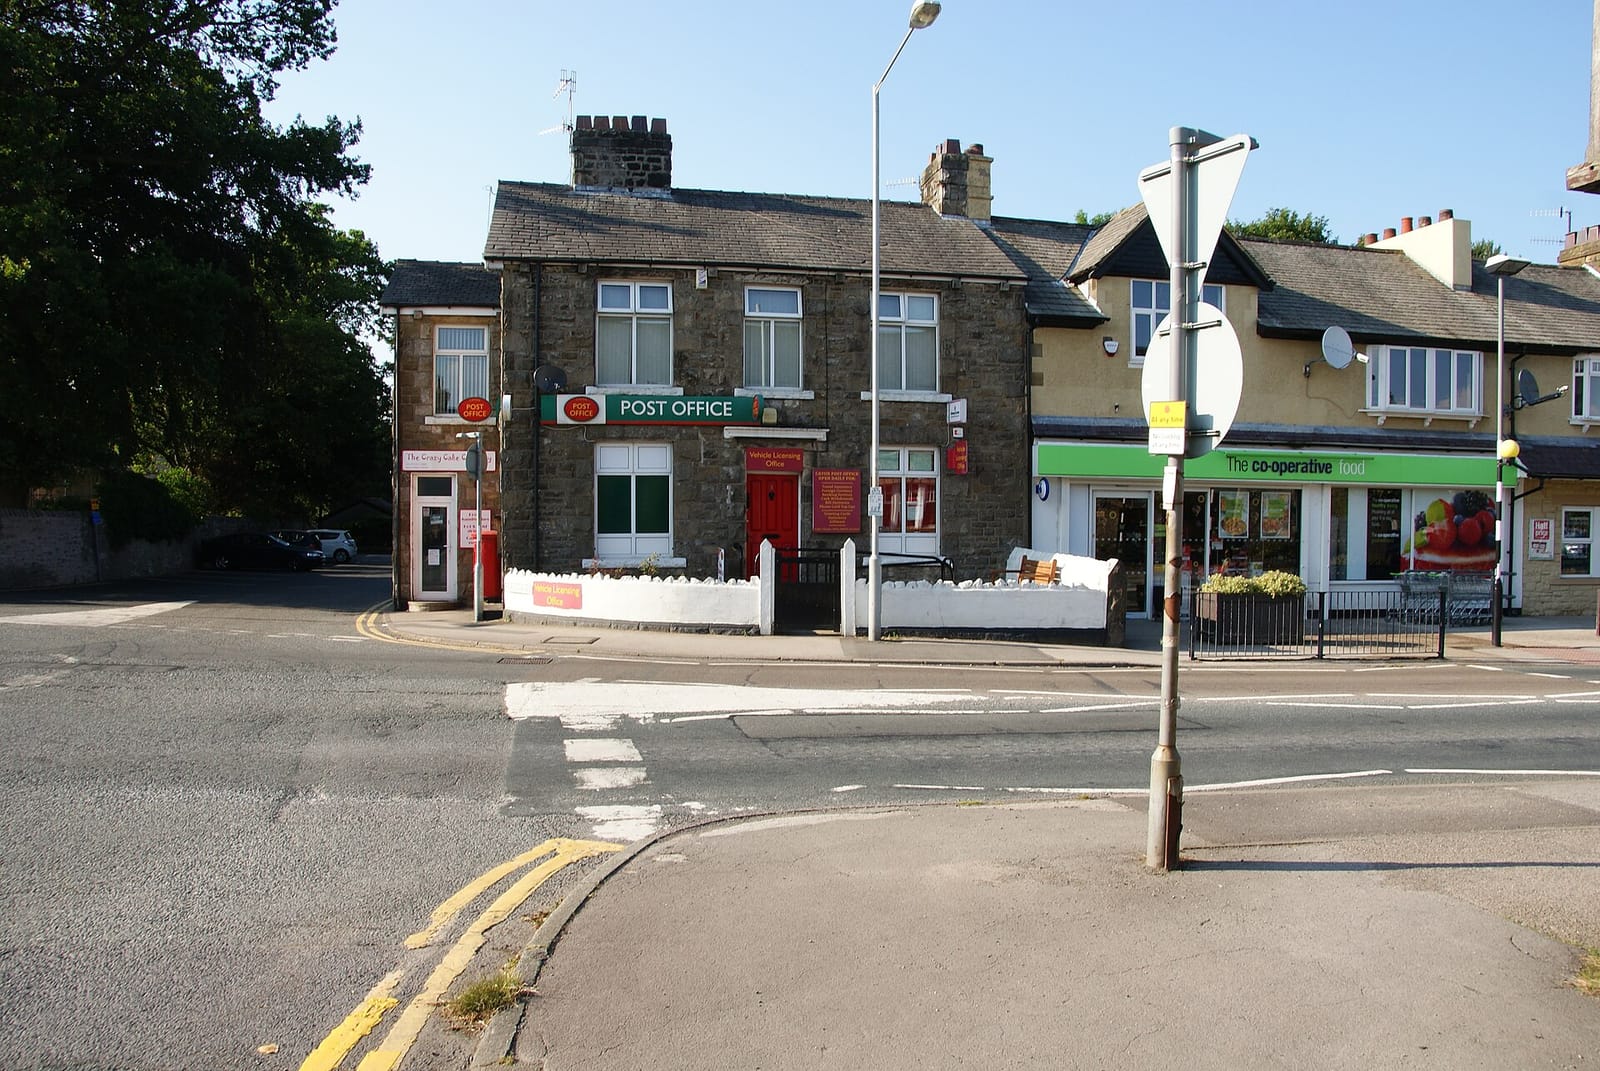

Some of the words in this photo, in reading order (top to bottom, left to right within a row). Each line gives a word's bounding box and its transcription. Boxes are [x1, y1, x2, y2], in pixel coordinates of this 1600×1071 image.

[620, 400, 667, 416] POST
[671, 400, 733, 417] OFFICE
[407, 453, 419, 461] The
[421, 453, 442, 463] Crazy
[443, 453, 459, 461] Cake
[749, 451, 772, 459] Vehicle
[772, 452, 801, 461] Licensing
[1226, 455, 1249, 473] The
[1251, 458, 1333, 476] co-operative
[1338, 459, 1366, 475] food
[1535, 521, 1549, 530] Half
[534, 583, 552, 593] Vehicle
[553, 584, 580, 598] Licensing
[546, 596, 564, 606] Office
